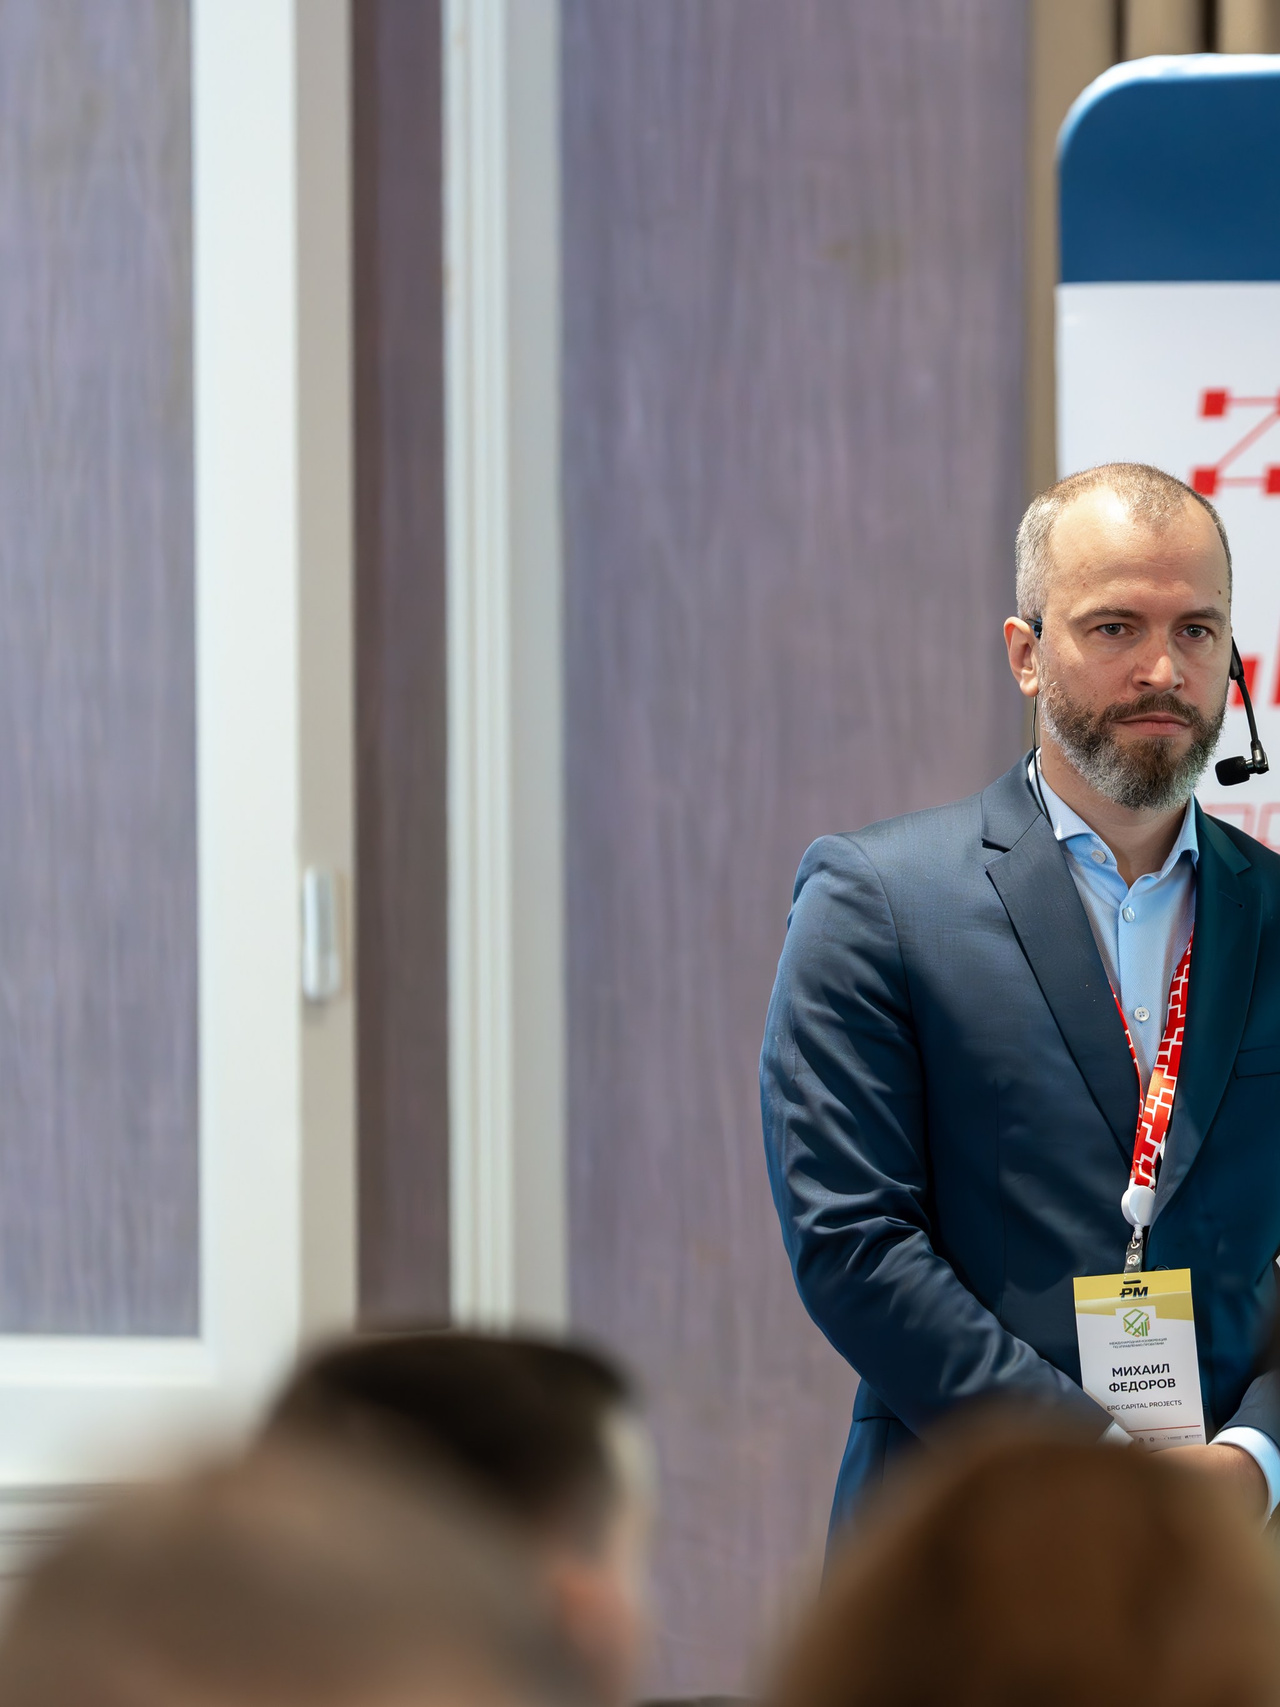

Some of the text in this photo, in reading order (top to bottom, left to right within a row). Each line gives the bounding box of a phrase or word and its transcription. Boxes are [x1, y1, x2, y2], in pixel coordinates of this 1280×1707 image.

[1119, 1286, 1149, 1298] PM
[1112, 1363, 1170, 1377] МИХАИЛ
[1108, 1378, 1176, 1393] ФЕДОРОВ
[1121, 1402, 1149, 1410] CAPITAL
[1149, 1399, 1183, 1408] PROJECTS
